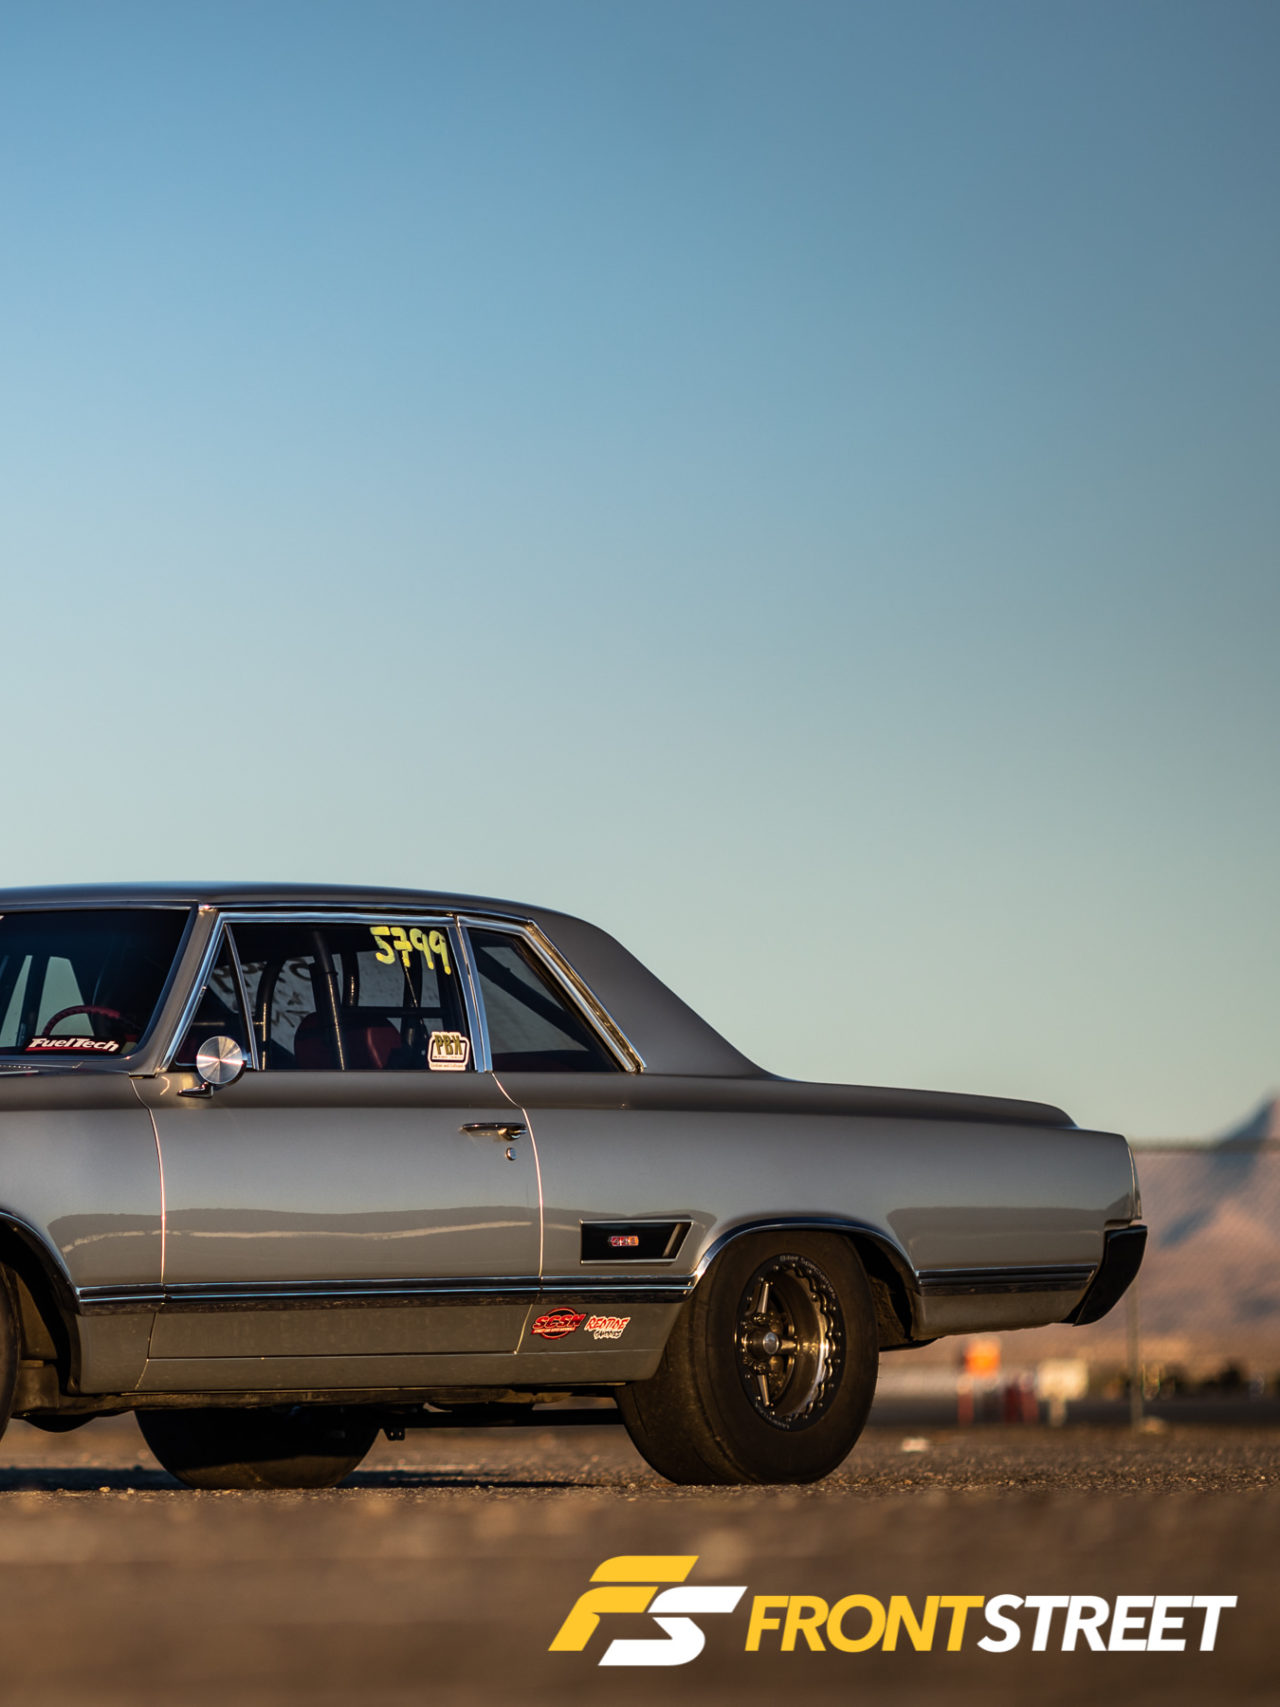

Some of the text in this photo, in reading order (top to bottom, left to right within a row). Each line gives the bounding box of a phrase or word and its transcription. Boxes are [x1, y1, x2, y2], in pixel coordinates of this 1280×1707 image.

[370, 925, 452, 975] 5799
[28, 1037, 120, 1052] FuelTech
[533, 1314, 586, 1329] SCSN
